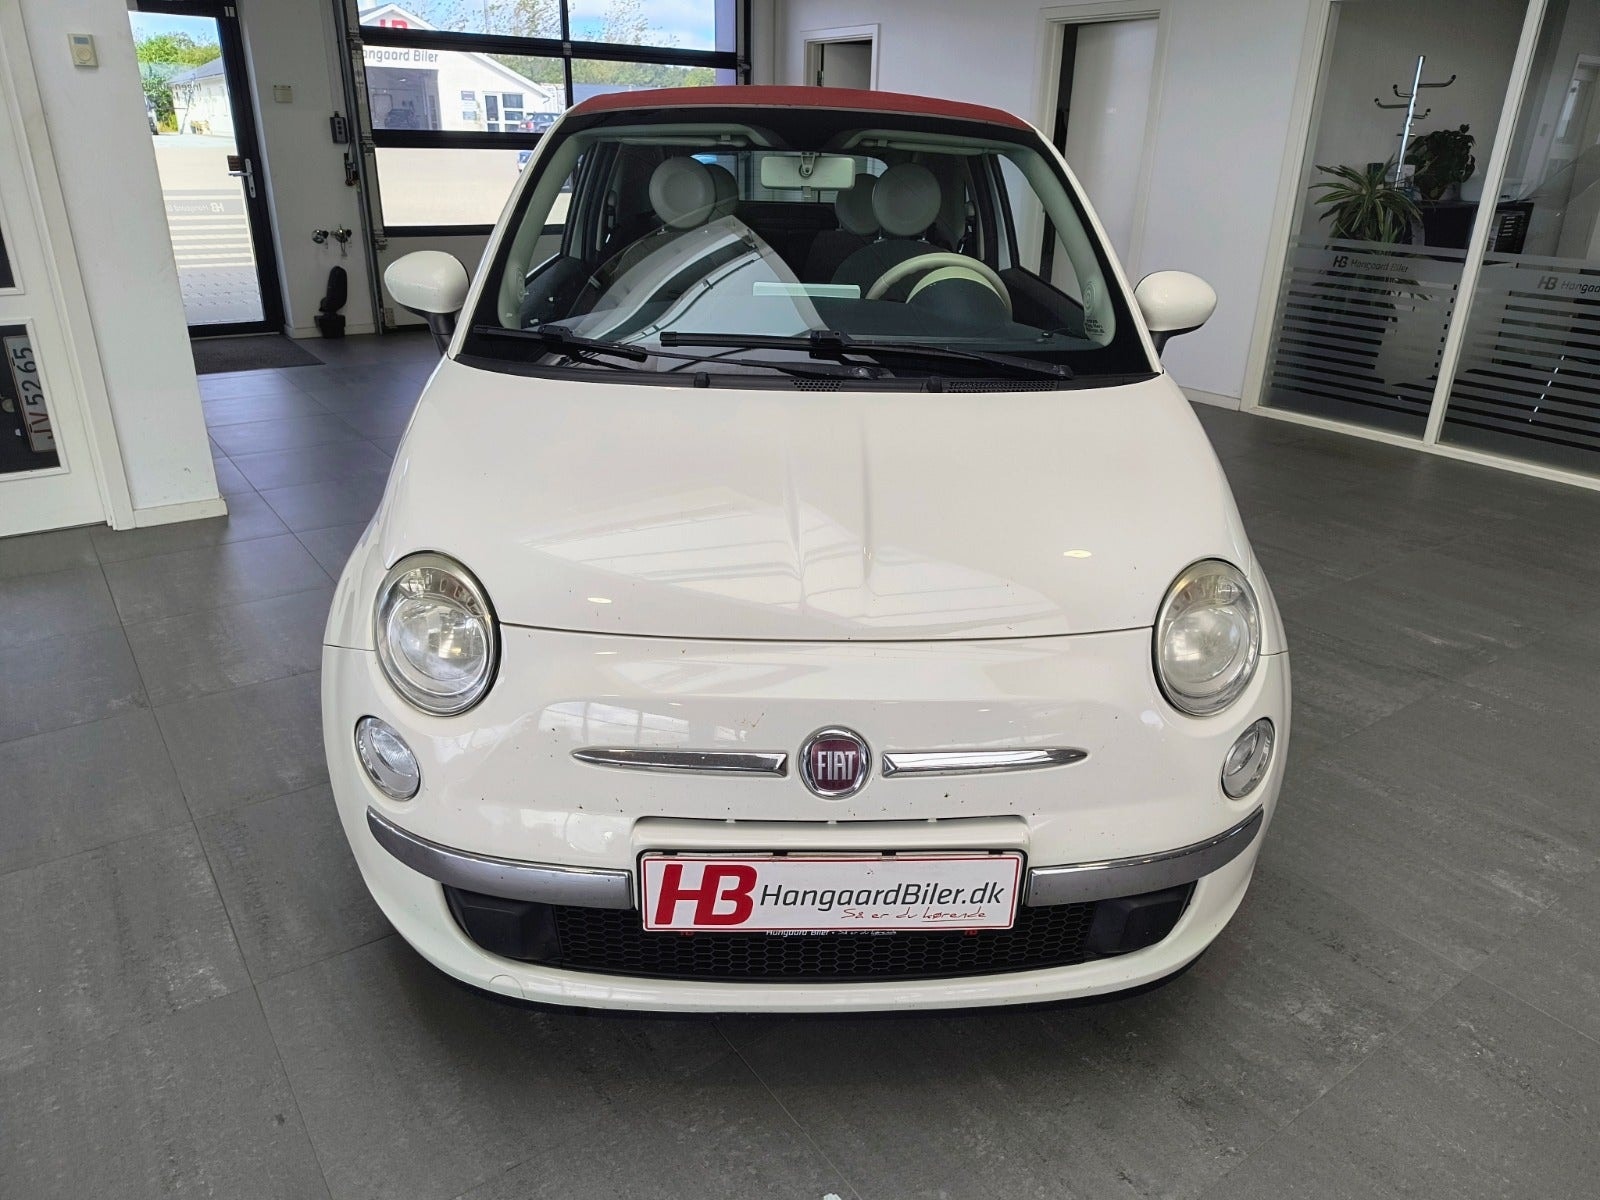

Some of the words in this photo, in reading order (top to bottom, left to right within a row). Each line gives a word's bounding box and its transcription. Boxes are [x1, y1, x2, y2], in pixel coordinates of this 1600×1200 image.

[362, 49, 410, 63] angaard
[413, 49, 439, 63] Biler
[1333, 255, 1349, 268] HB
[1536, 275, 1559, 290] HB
[817, 750, 857, 781] FIAT
[654, 863, 758, 926] HB
[759, 881, 1005, 912] HangaardBiler.dk
[895, 906, 918, 919] du
[922, 906, 987, 920] kørende
